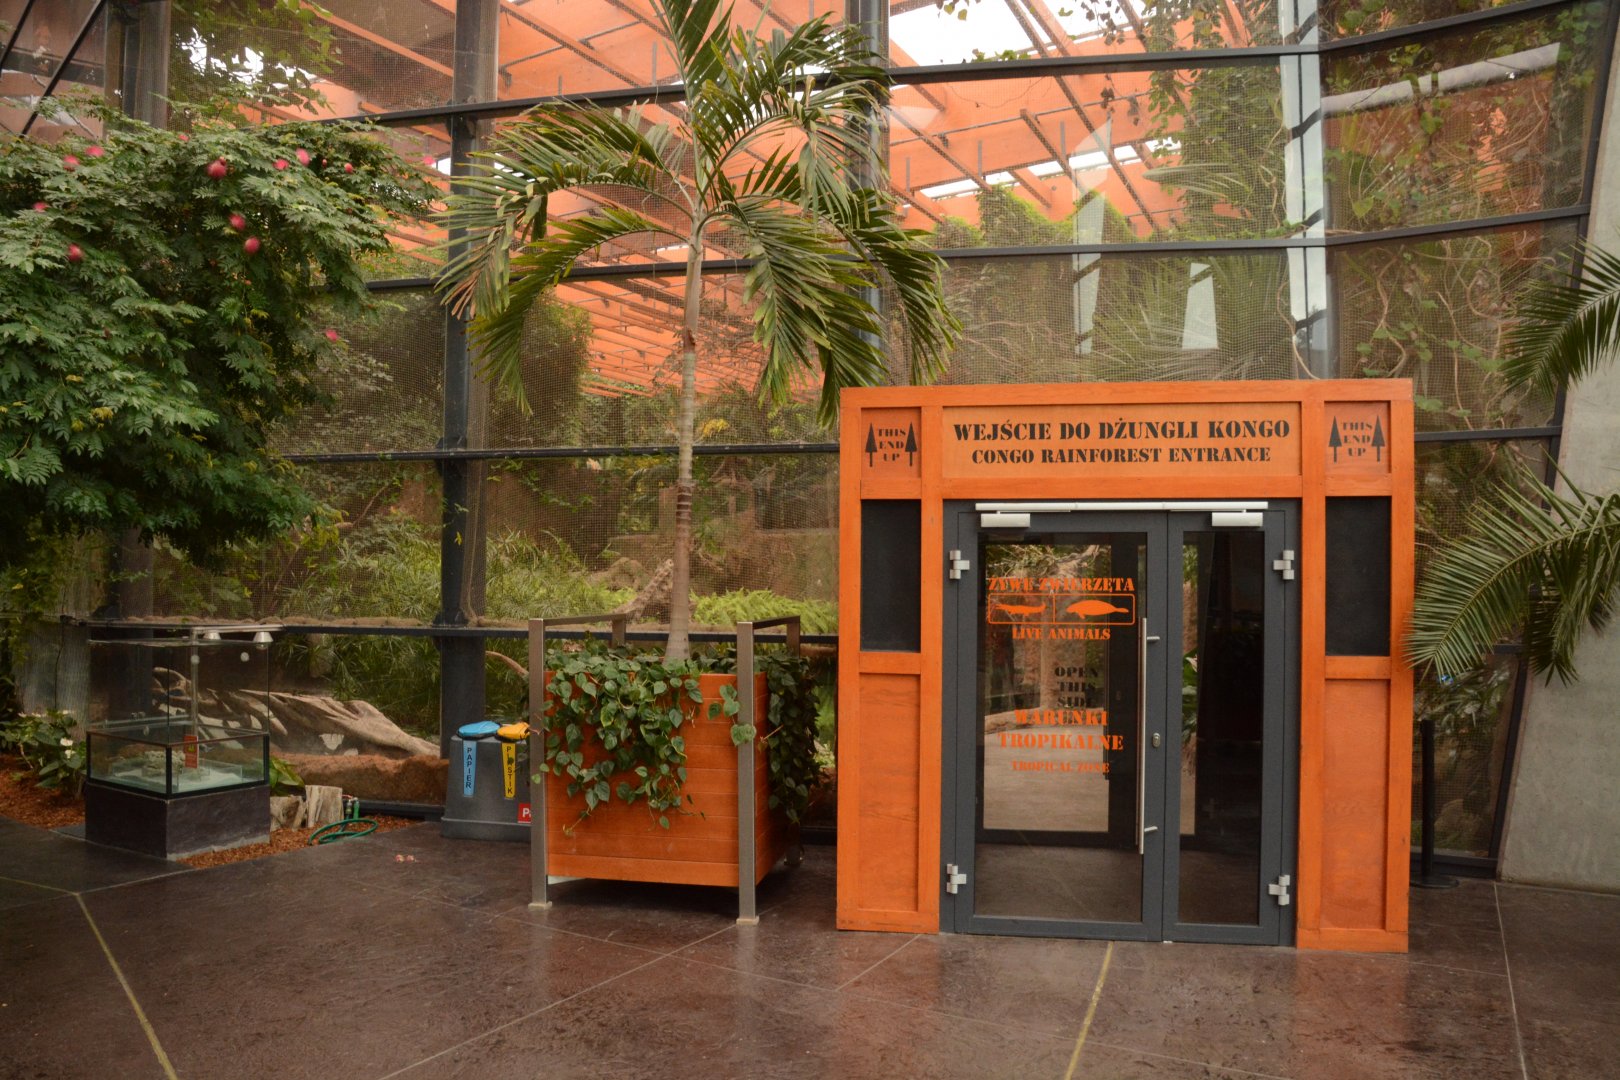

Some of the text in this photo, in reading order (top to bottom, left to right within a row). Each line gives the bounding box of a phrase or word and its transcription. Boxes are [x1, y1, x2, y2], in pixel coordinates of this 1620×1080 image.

[877, 428, 906, 437] THIS
[953, 417, 1290, 441] WEJŚCIE DO DŻUNGLI KONGO
[1342, 422, 1373, 431] THIS
[879, 441, 904, 449] END
[1343, 435, 1371, 443] END
[971, 447, 1271, 464] CONGO RAINFOREST ENTRANCE
[1012, 628, 1111, 640] LIVE ANIMALS
[1014, 709, 1107, 726] WARUNKI
[998, 733, 1123, 750] TROPIKALNE
